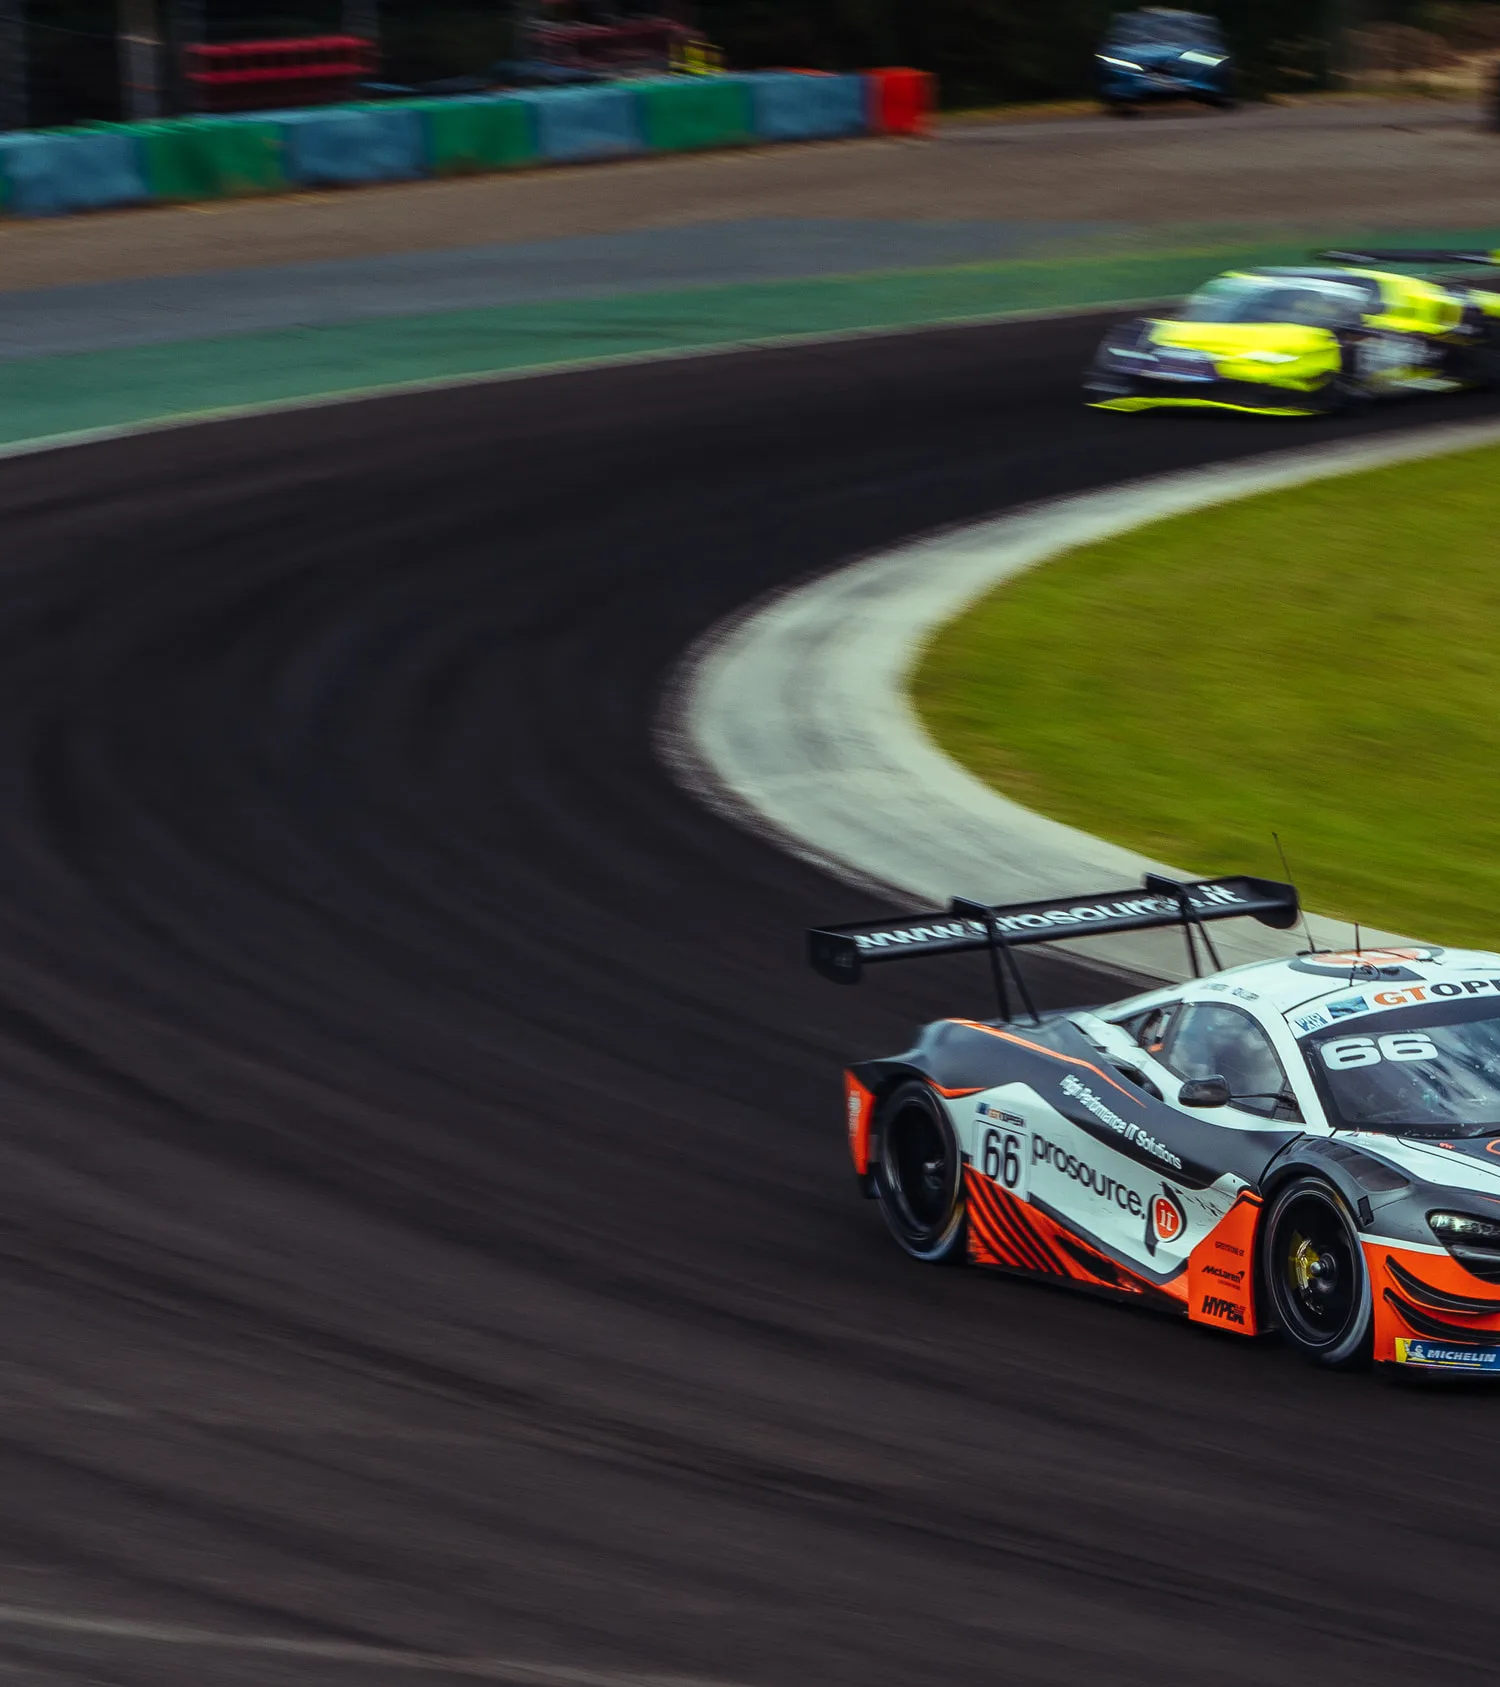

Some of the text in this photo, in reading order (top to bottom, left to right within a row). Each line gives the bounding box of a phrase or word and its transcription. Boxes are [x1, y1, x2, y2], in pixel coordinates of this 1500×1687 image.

[1320, 1033, 1438, 1070] 66
[1076, 1088, 1127, 1134] Performance
[1124, 1122, 1139, 1140] IT
[1136, 1130, 1182, 1169] Solutions
[984, 1128, 1021, 1189] 66
[1202, 1265, 1241, 1283] McLaren
[1427, 1349, 1497, 1362] MICHELIN
